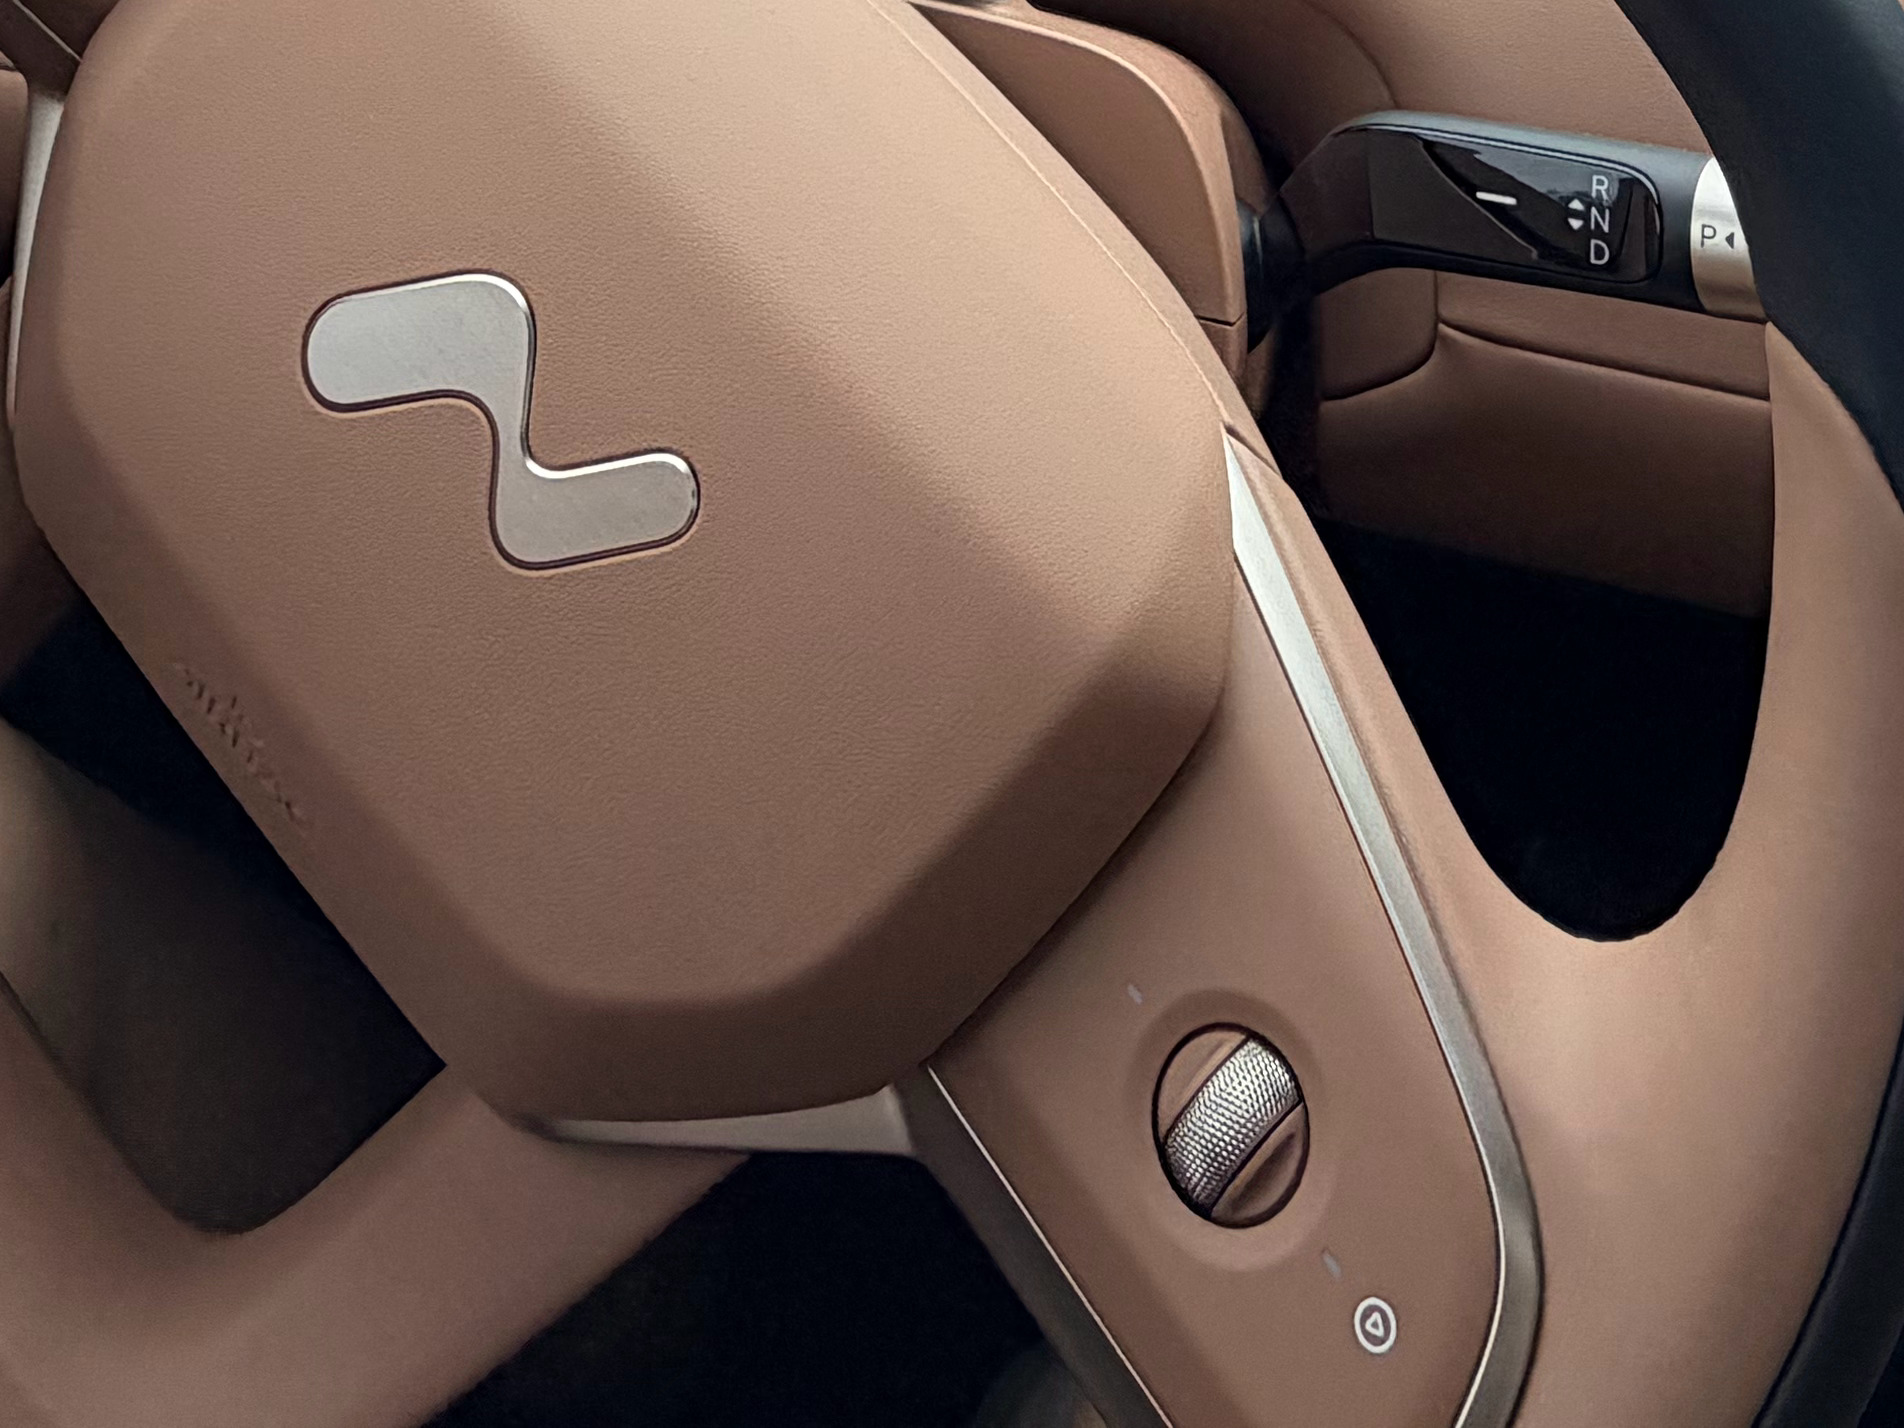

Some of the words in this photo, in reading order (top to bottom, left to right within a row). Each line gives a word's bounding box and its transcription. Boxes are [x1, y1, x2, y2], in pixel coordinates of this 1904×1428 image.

[1591, 174, 1611, 206] R
[1590, 206, 1610, 233] N
[1701, 224, 1717, 248] P
[1590, 239, 1610, 265] D
